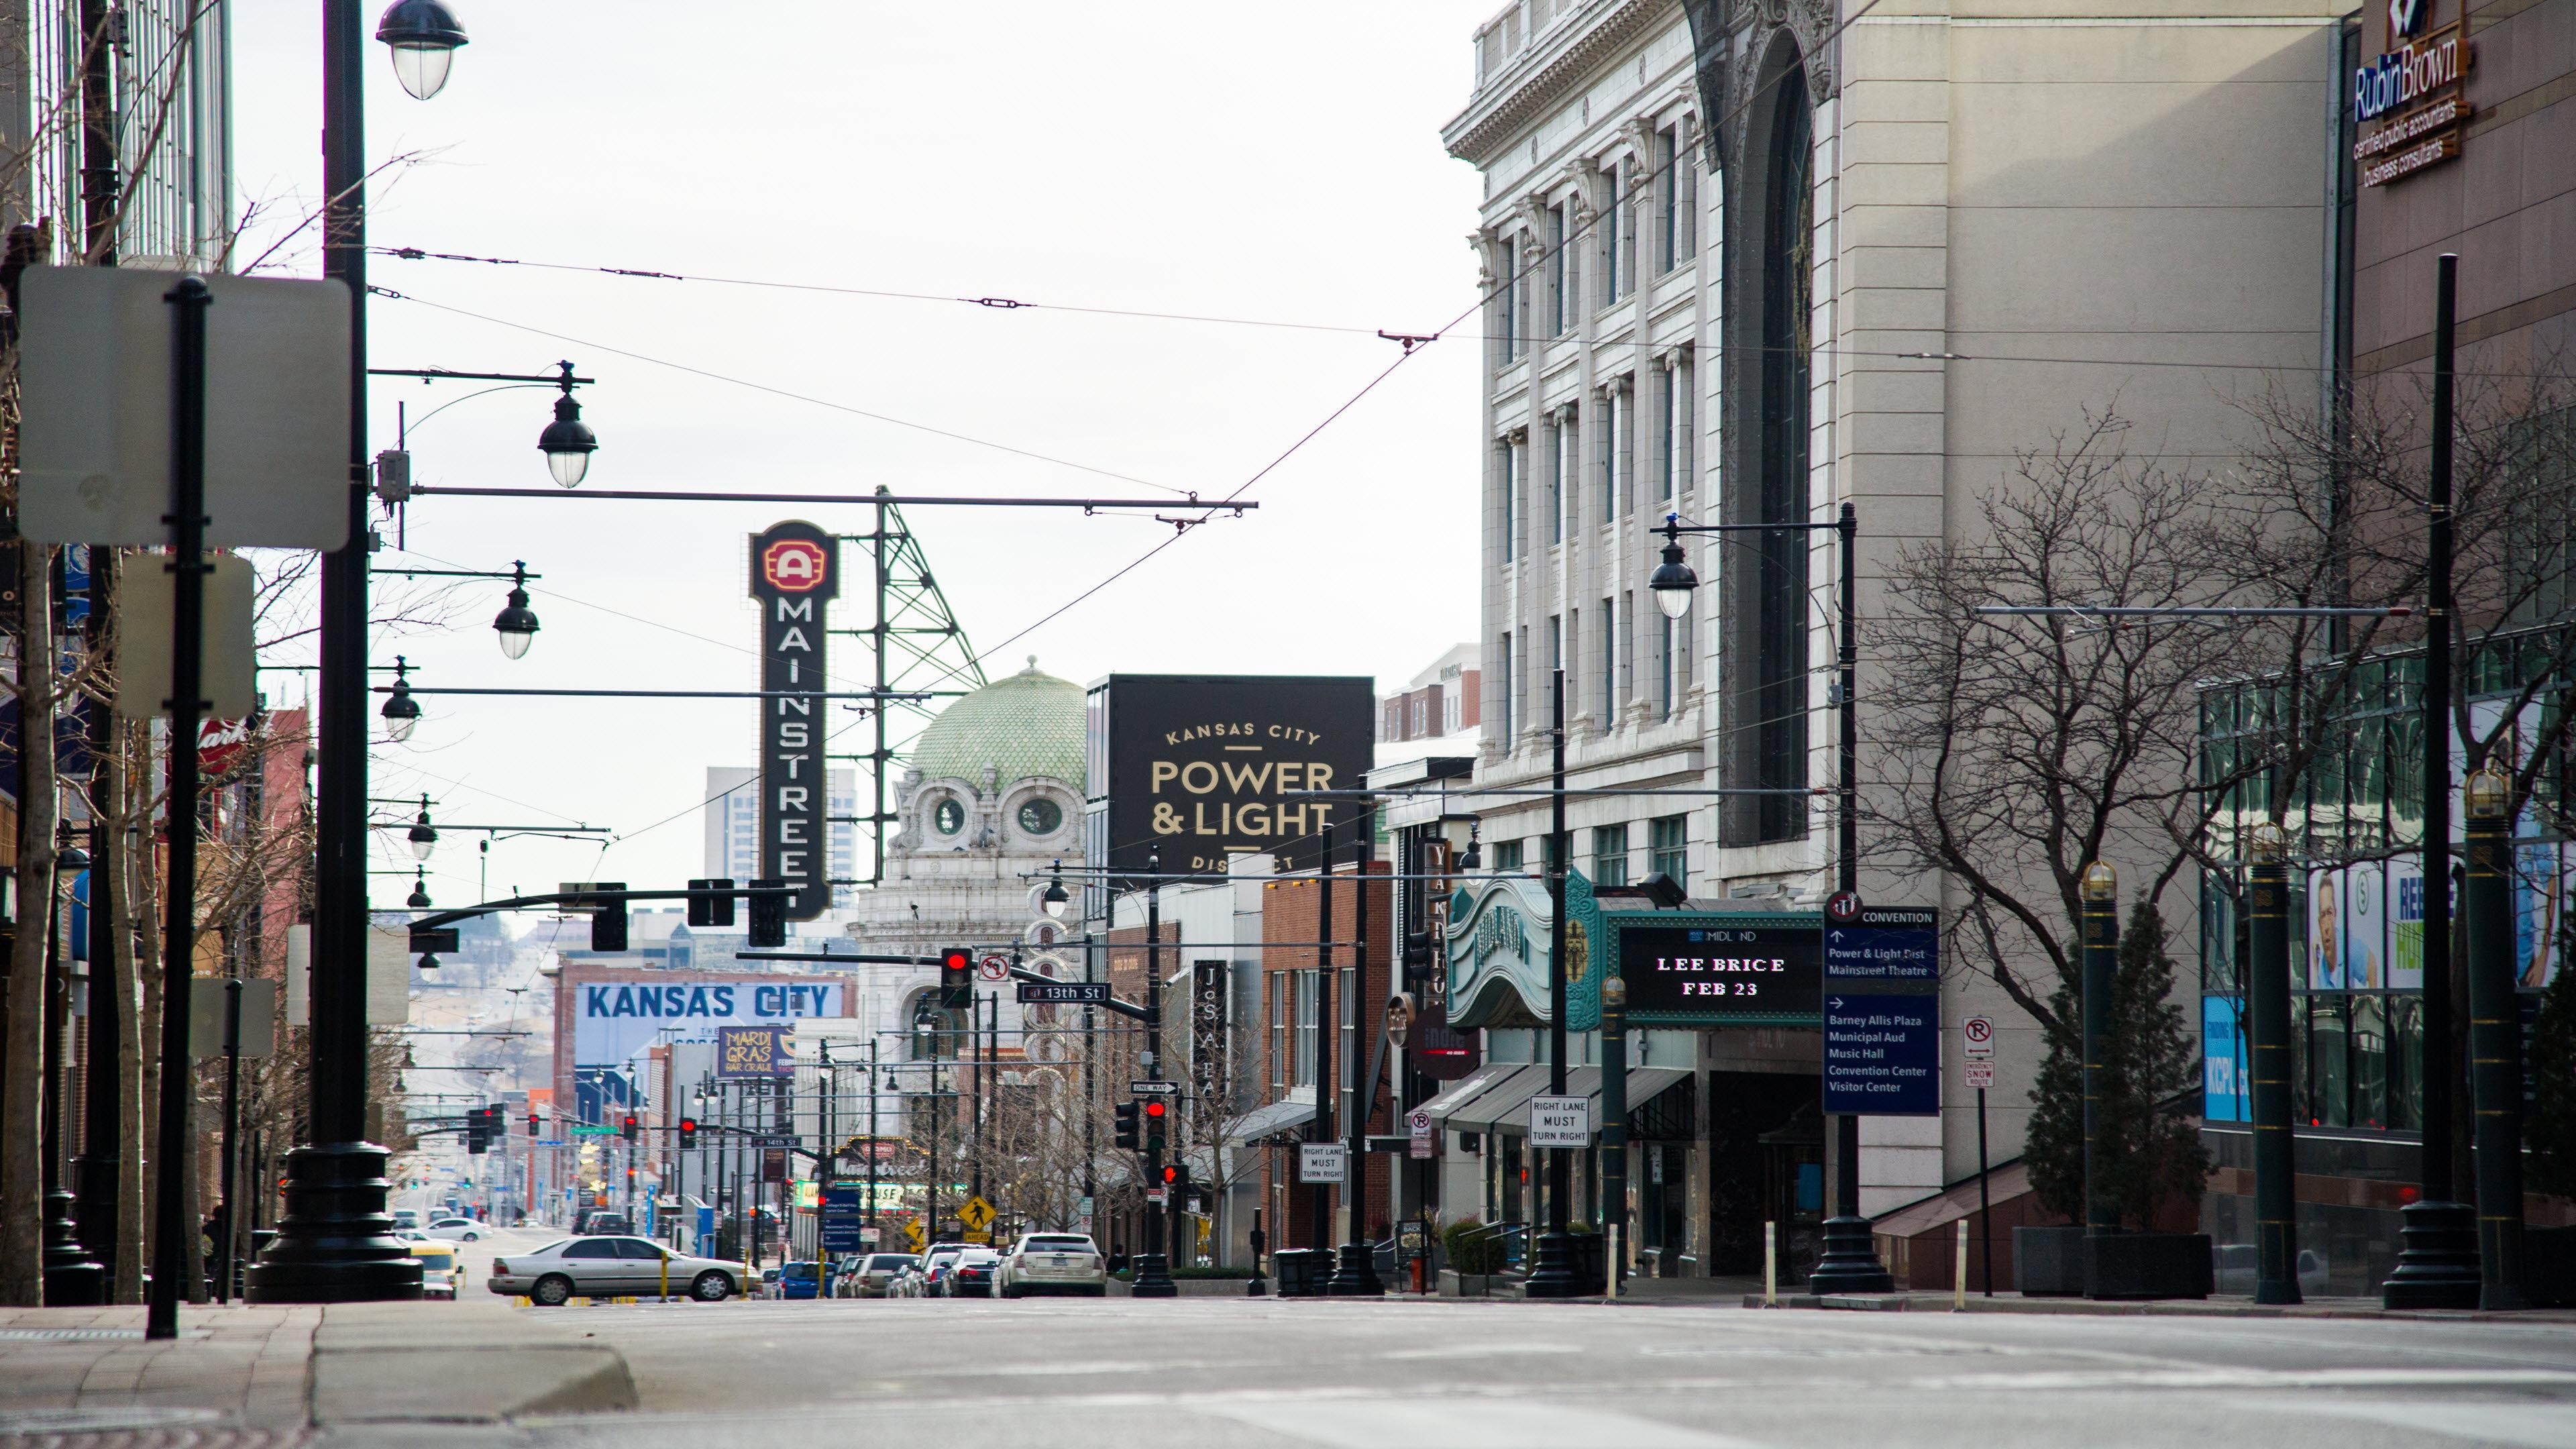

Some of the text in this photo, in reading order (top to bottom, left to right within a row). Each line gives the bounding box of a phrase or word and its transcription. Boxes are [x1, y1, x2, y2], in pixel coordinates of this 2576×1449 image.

[2355, 38, 2457, 122] RubinBrown
[2353, 99, 2457, 160] certified public accountants
[2364, 138, 2443, 187] business consultants
[1166, 722, 1321, 746] KANSAS CITY
[1152, 761, 1334, 795] POWER
[1152, 802, 1333, 836] & LIGHT
[1191, 855, 1293, 873] DISCT
[1862, 912, 1933, 923] CONVENTION
[1707, 931, 1756, 942] MIDLND
[1829, 948, 1925, 961] Power & Light Dist
[1657, 958, 1785, 971] LEE BRICE
[1829, 965, 1927, 975] Mainstreet Theatre
[1046, 987, 1099, 998] 13th St
[1682, 982, 1758, 996] FEB 23
[588, 986, 829, 1018] KANSAS CITY
[1829, 1015, 1923, 1028] Barney Allis Plaza
[726, 1031, 773, 1046] MARDI
[1829, 1032, 1906, 1044] Municipal Aud
[727, 1046, 771, 1063] GRAS
[1829, 1049, 1884, 1059] Music Hall
[725, 1063, 774, 1072] BAR CRAWL
[1829, 1065, 1927, 1077] Convention Center
[1967, 1070, 1992, 1078] SNOW
[1829, 1081, 1902, 1092] Visitor Center
[1534, 1102, 1586, 1111] RIGHT LANE
[1544, 1116, 1576, 1126] MUST
[1534, 1132, 1586, 1140] TURN RIGHT
